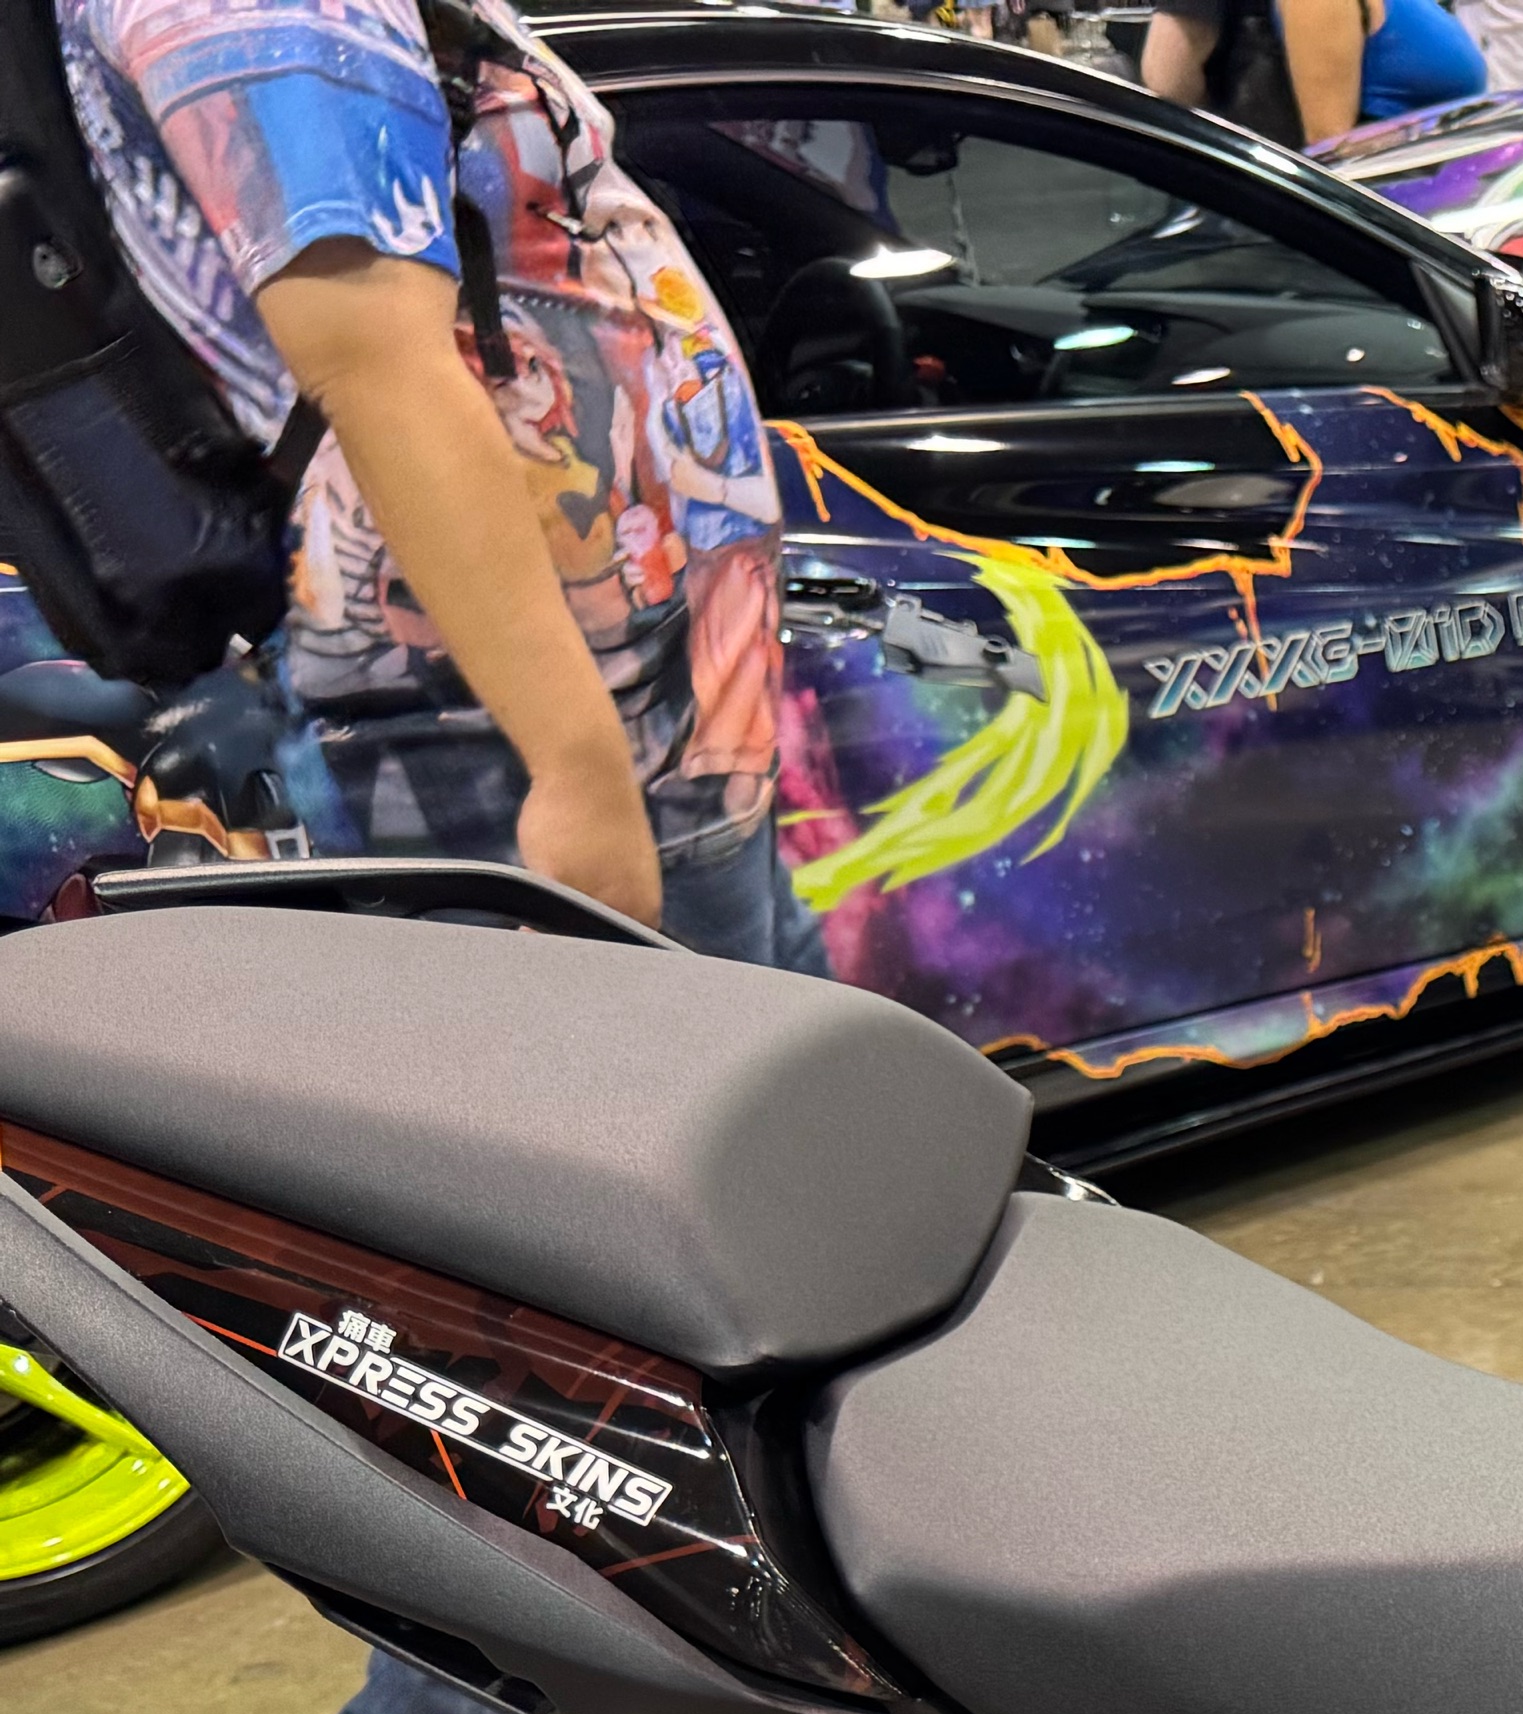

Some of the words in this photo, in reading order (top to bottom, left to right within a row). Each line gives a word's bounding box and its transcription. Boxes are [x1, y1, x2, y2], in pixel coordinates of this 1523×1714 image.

[338, 1309, 397, 1355] 痛車
[286, 1316, 491, 1437] XPRESS
[499, 1423, 665, 1518] SKINS
[546, 1486, 604, 1531] 文化
